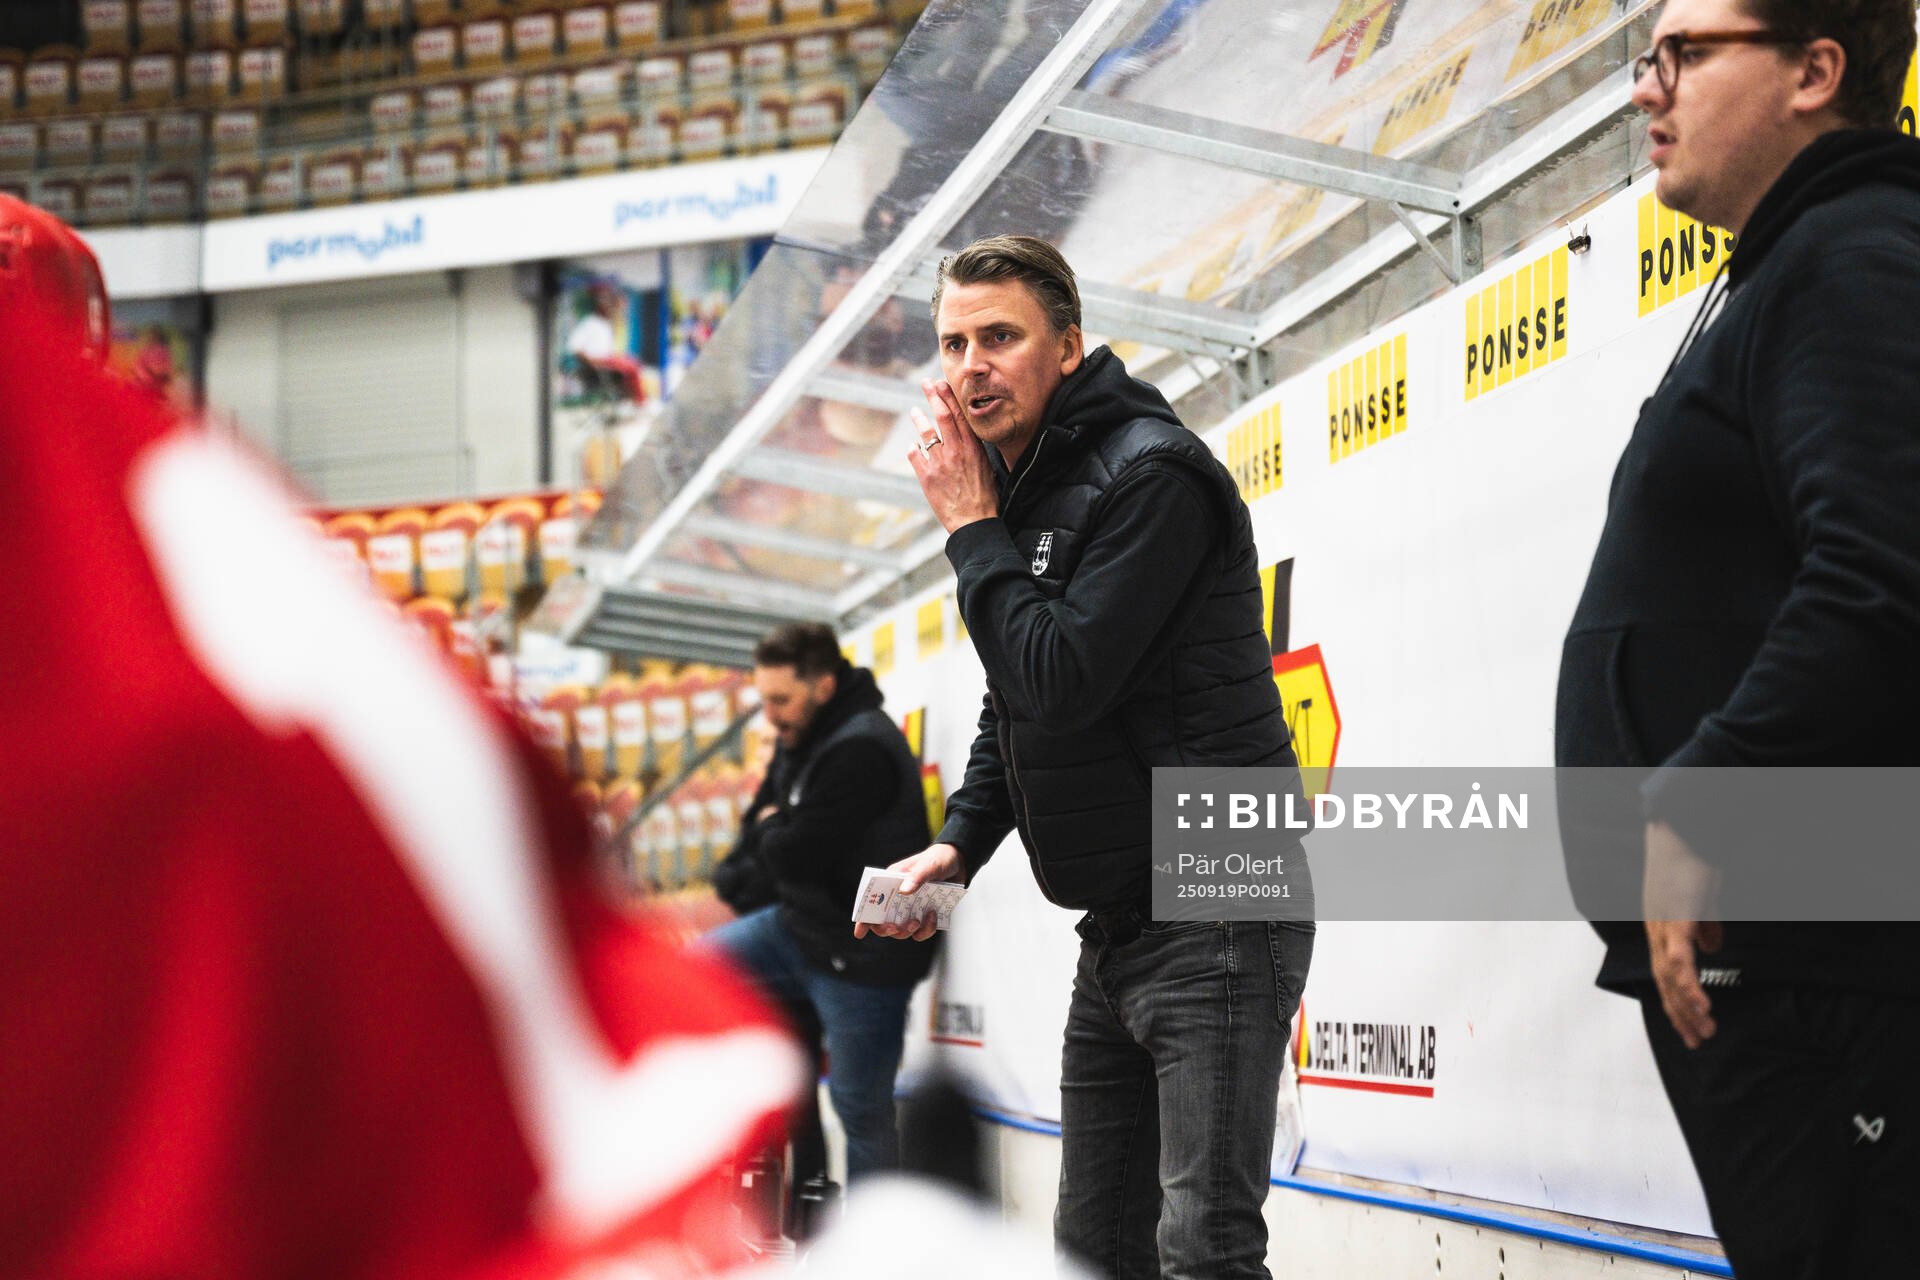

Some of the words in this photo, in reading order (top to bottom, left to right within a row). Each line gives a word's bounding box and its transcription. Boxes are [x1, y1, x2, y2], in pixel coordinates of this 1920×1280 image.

[1467, 297, 1565, 384] PONSSE
[1330, 379, 1405, 449] PONSSE
[1316, 1021, 1349, 1073] DELTA
[1353, 1023, 1413, 1079] TERMINAL
[1418, 1026, 1436, 1080] AB
